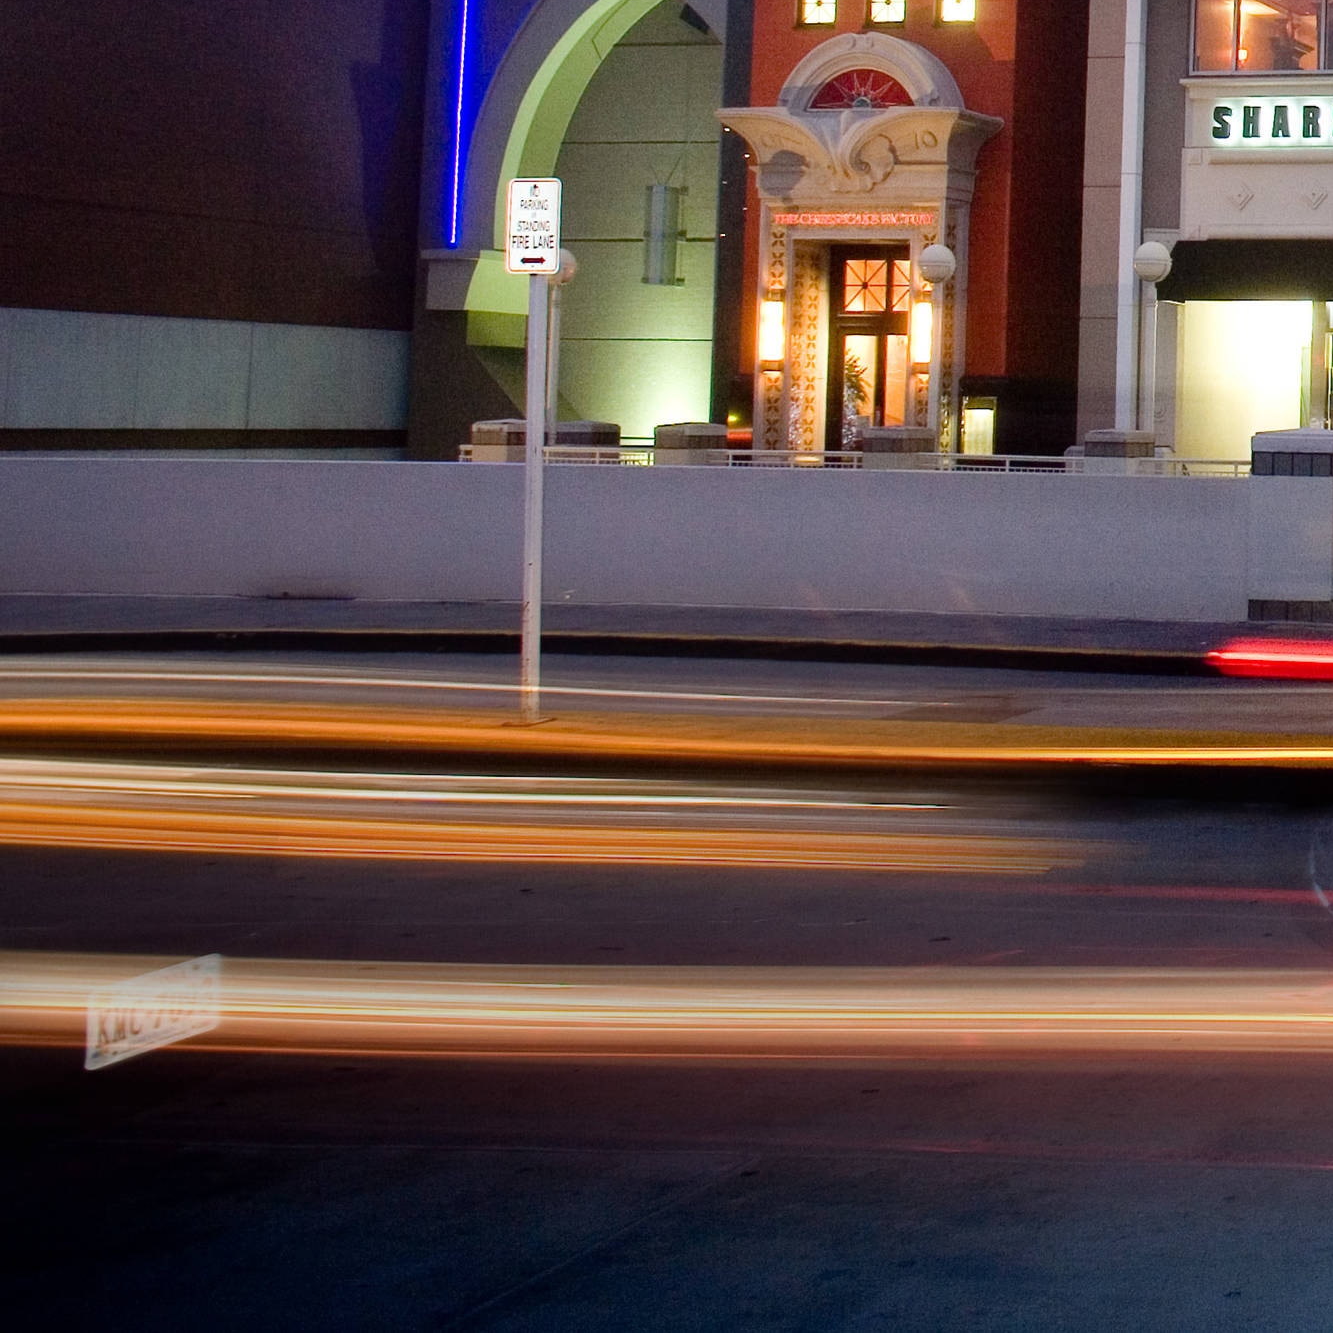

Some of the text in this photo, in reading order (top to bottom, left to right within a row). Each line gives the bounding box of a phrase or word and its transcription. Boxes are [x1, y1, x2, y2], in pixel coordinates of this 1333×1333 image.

[519, 199, 549, 210] PARKING
[517, 220, 550, 232] STANDING
[511, 234, 555, 250] FIRE LANE
